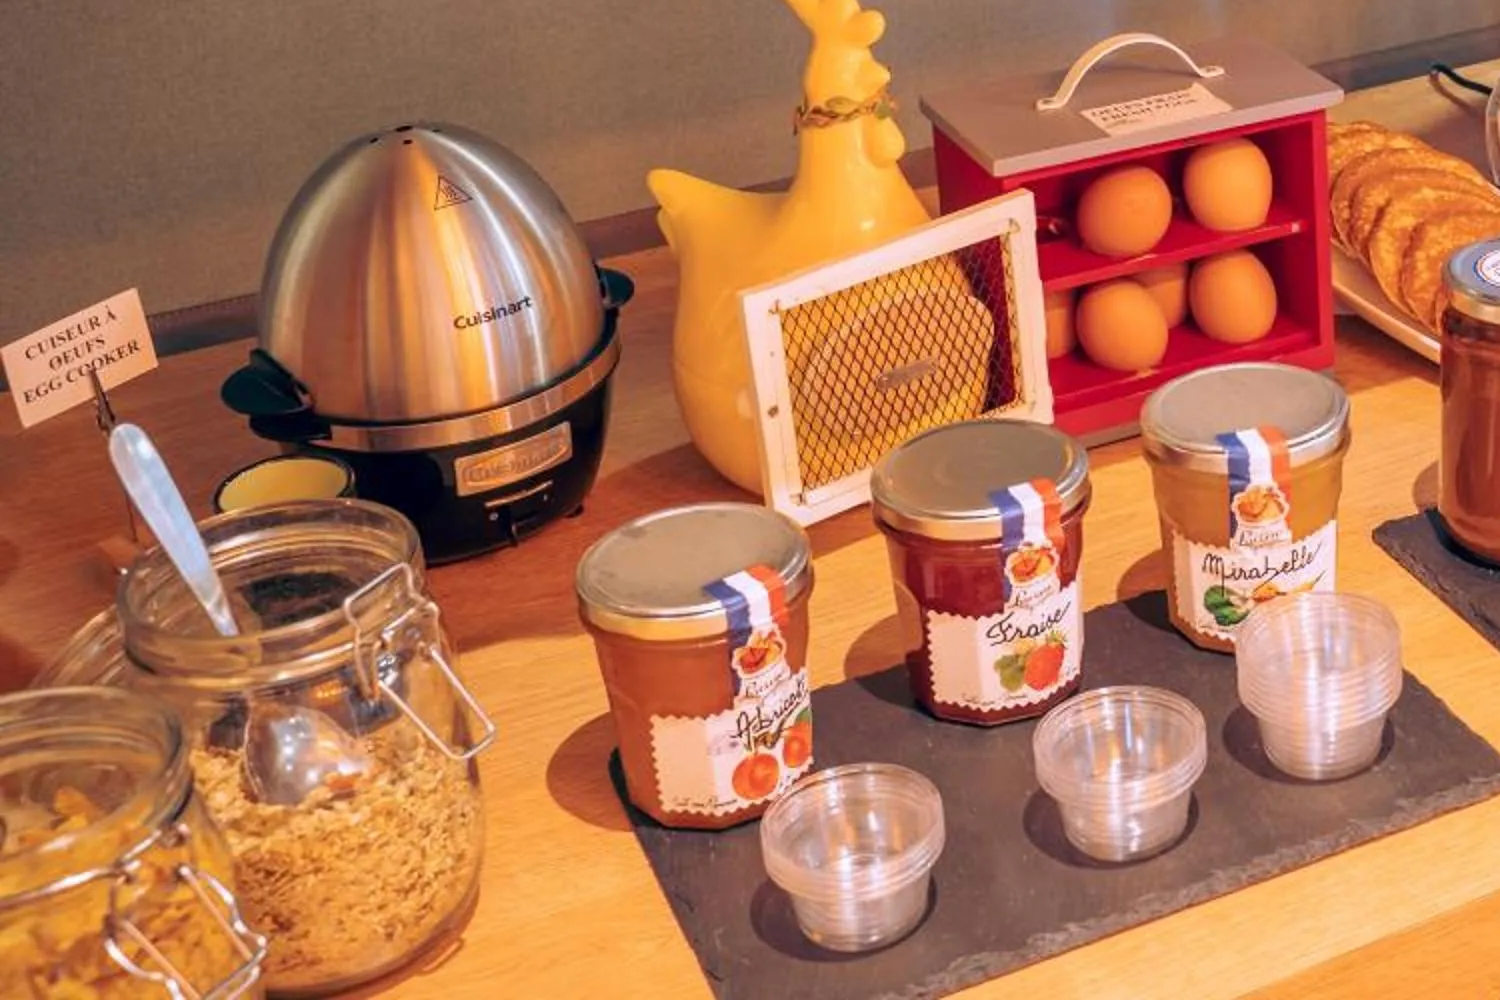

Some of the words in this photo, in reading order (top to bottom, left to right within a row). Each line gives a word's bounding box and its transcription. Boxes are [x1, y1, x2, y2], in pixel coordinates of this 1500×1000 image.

[453, 296, 532, 329] Cuisinart
[25, 315, 101, 361] CUISEUR
[23, 377, 63, 404] EGG
[65, 338, 141, 384] COOKER
[1202, 541, 1322, 583] Mirabelle
[986, 600, 1071, 646] Fraise
